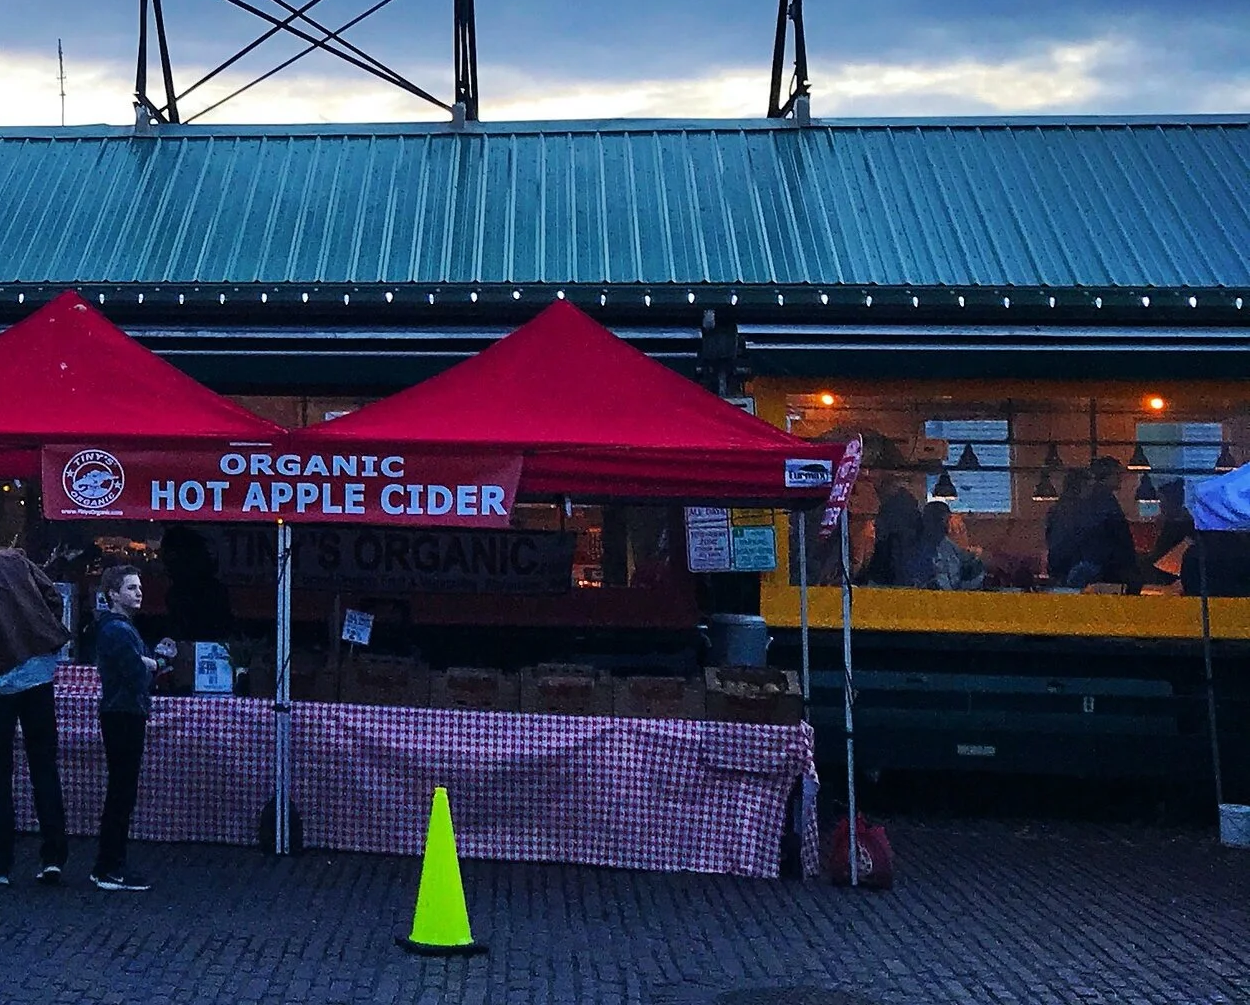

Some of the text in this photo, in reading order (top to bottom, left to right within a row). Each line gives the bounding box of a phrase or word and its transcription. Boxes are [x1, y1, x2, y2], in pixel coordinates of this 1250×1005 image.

[72, 452, 115, 466] TINY'S
[219, 453, 405, 478] ORGANIC
[70, 491, 116, 507] ORGANIC
[151, 480, 508, 516] HOT APPLE CIDER
[353, 531, 538, 575] ORGANIC
